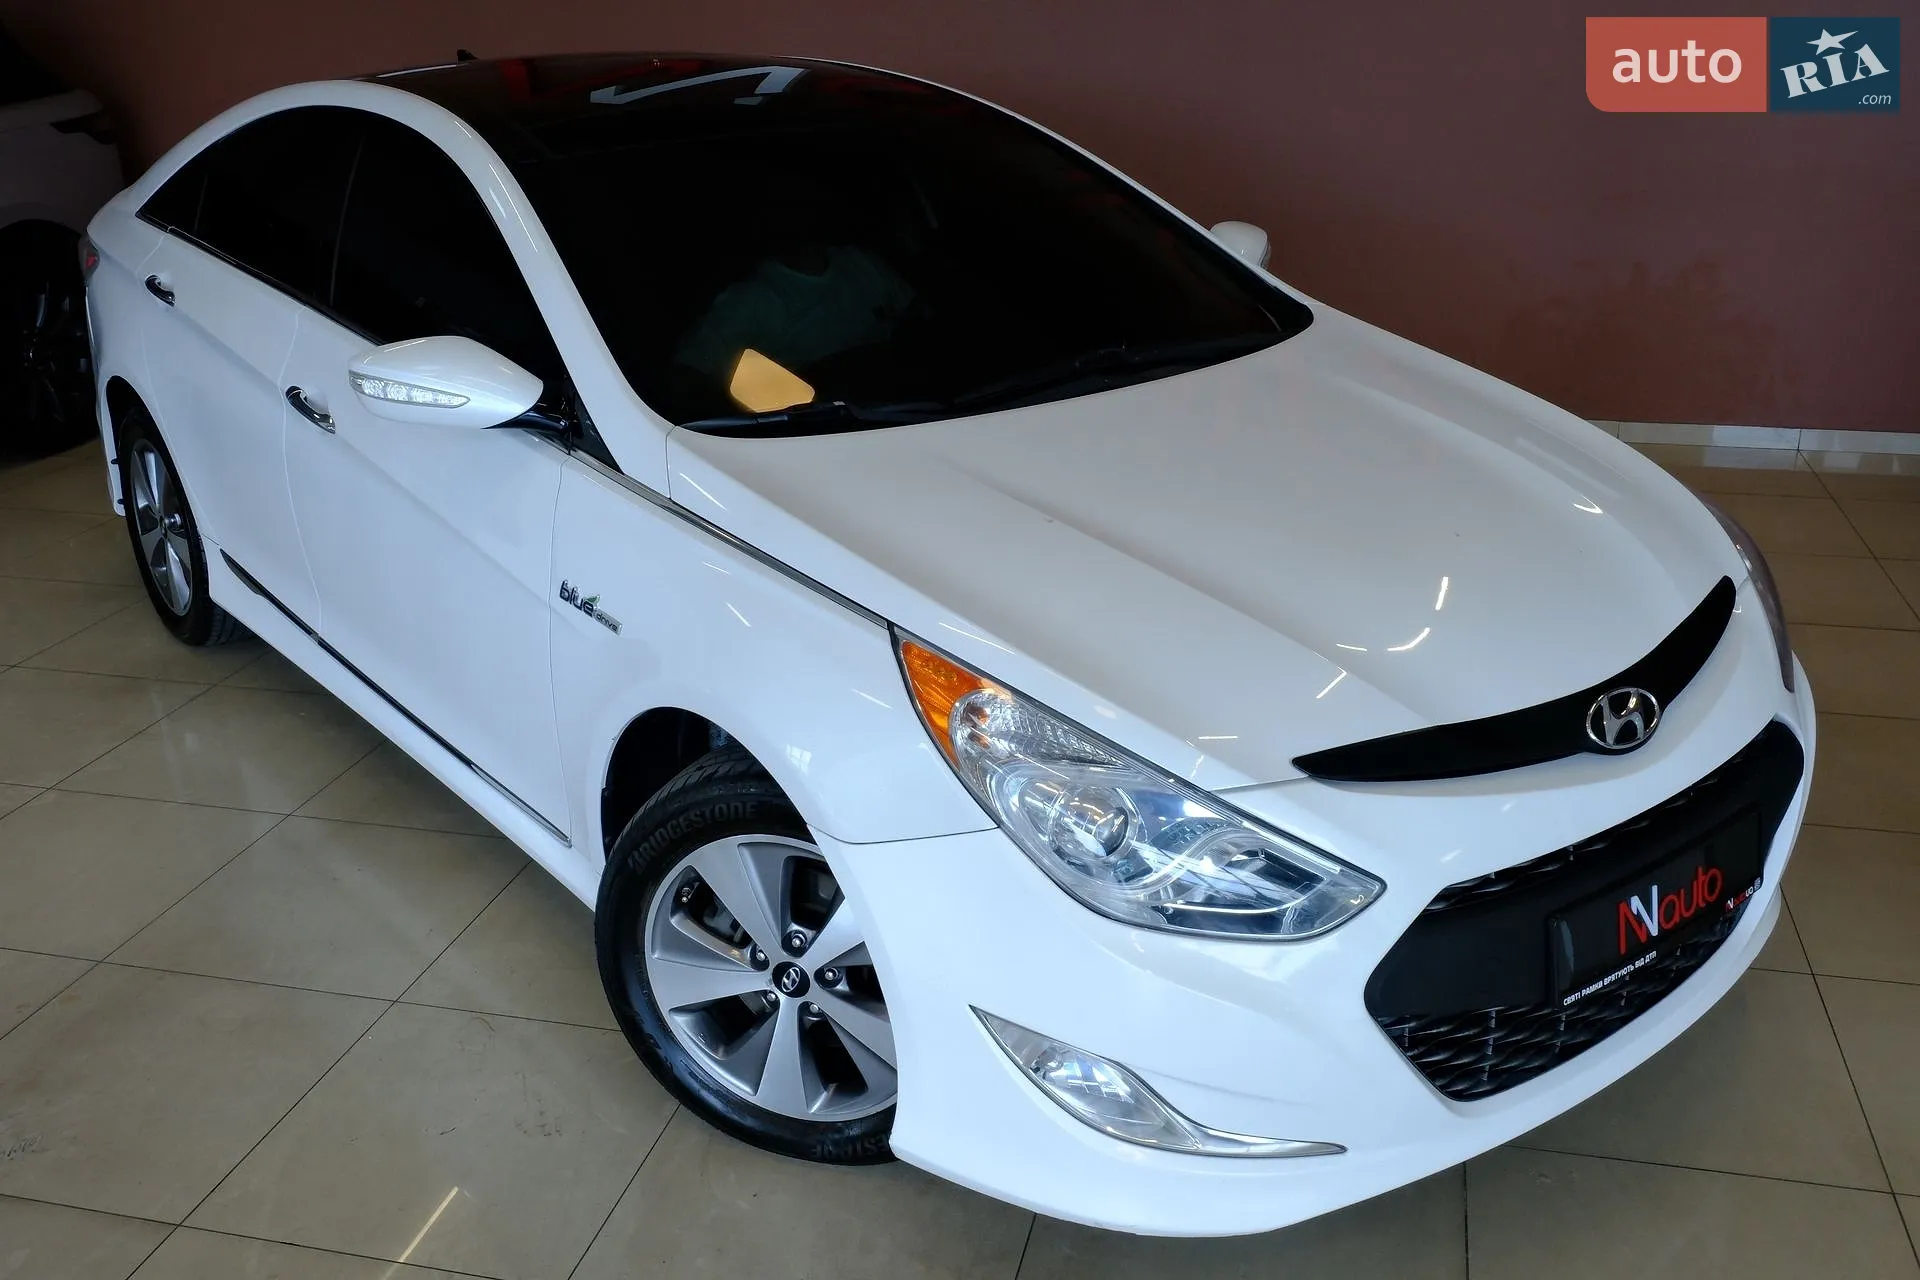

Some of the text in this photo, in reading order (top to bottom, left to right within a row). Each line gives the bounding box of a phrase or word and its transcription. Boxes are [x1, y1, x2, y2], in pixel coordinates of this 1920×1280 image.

[559, 579, 594, 618] blue
[595, 612, 619, 633] drive
[627, 801, 757, 875] BRIDGESTONE
